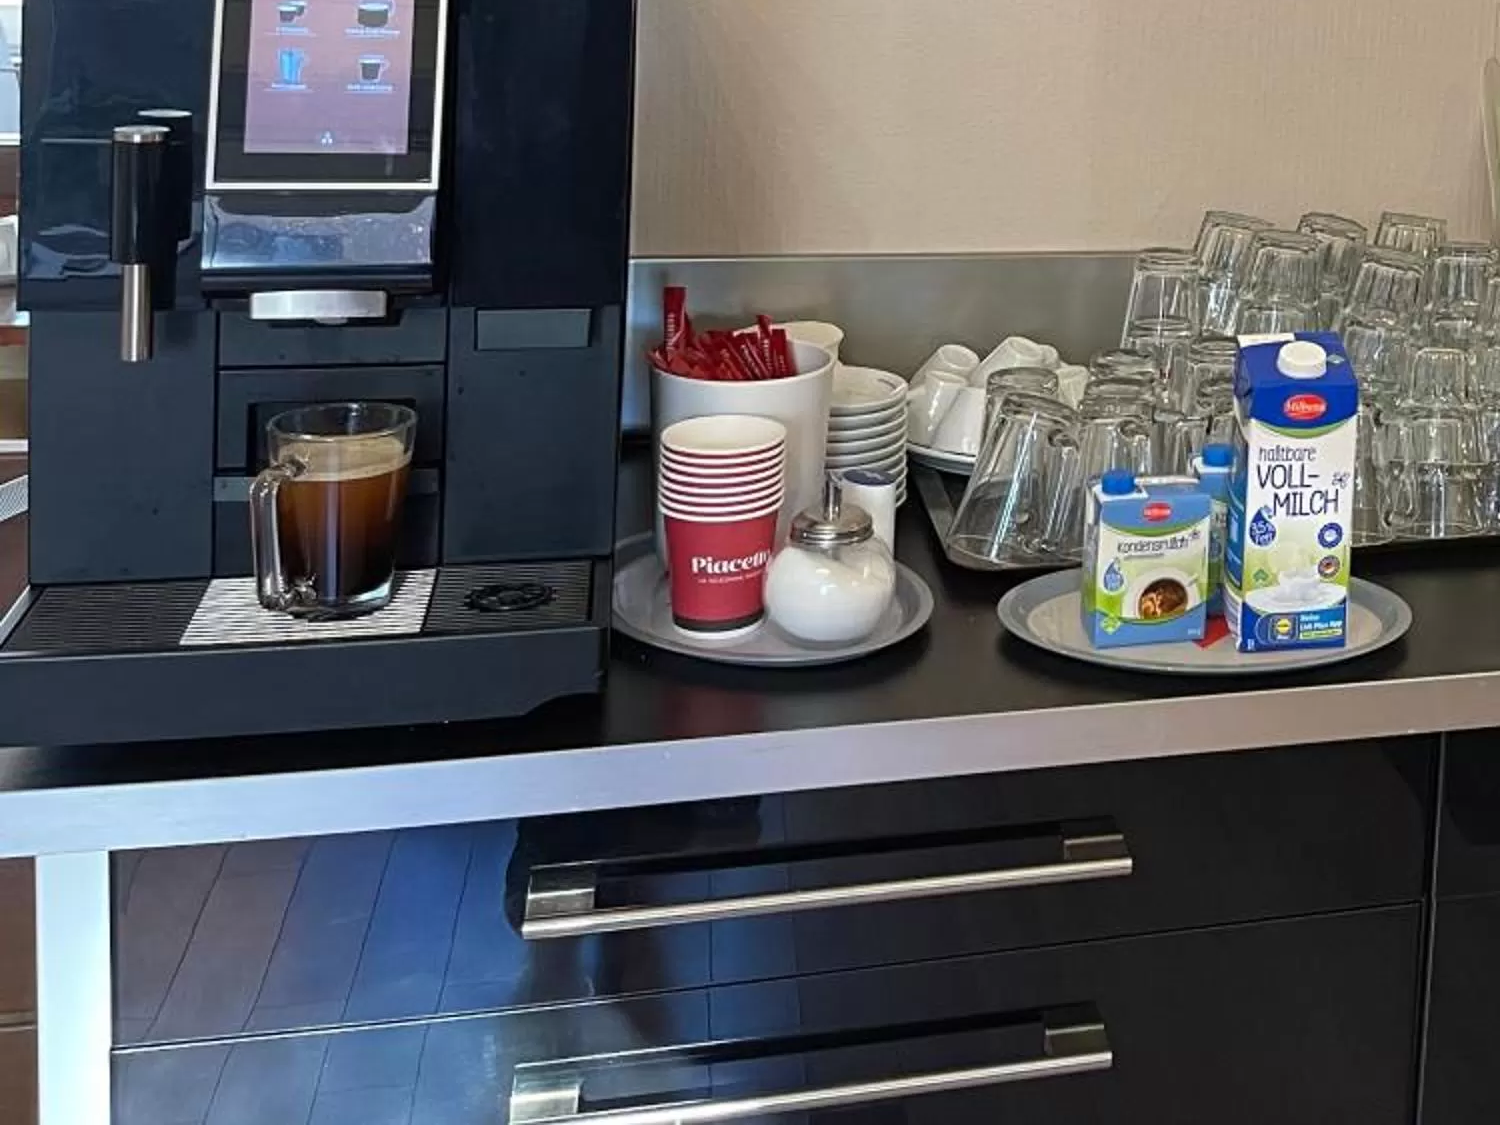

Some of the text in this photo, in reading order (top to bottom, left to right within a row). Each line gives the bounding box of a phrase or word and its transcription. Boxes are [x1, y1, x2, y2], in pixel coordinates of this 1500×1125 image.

[1259, 444, 1317, 462] haltbare
[1257, 462, 1320, 490] VOLL-
[1273, 489, 1339, 516] MILCH
